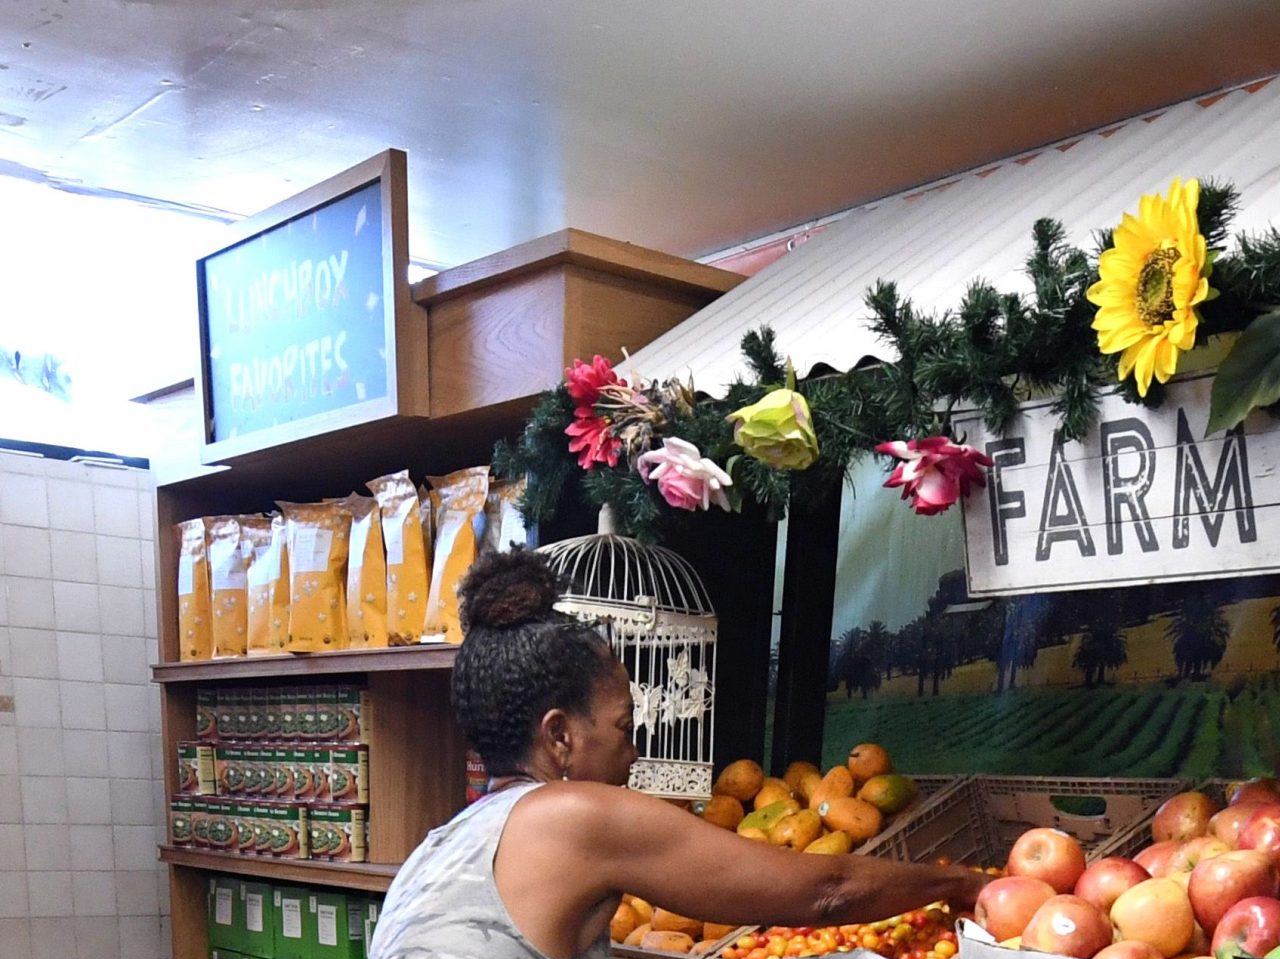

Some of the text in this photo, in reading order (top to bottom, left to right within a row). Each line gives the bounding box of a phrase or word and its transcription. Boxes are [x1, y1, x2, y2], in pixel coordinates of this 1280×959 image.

[226, 250, 349, 334] LUNCHBOX
[230, 330, 349, 411] FAVORITES
[984, 406, 1257, 567] FARM
